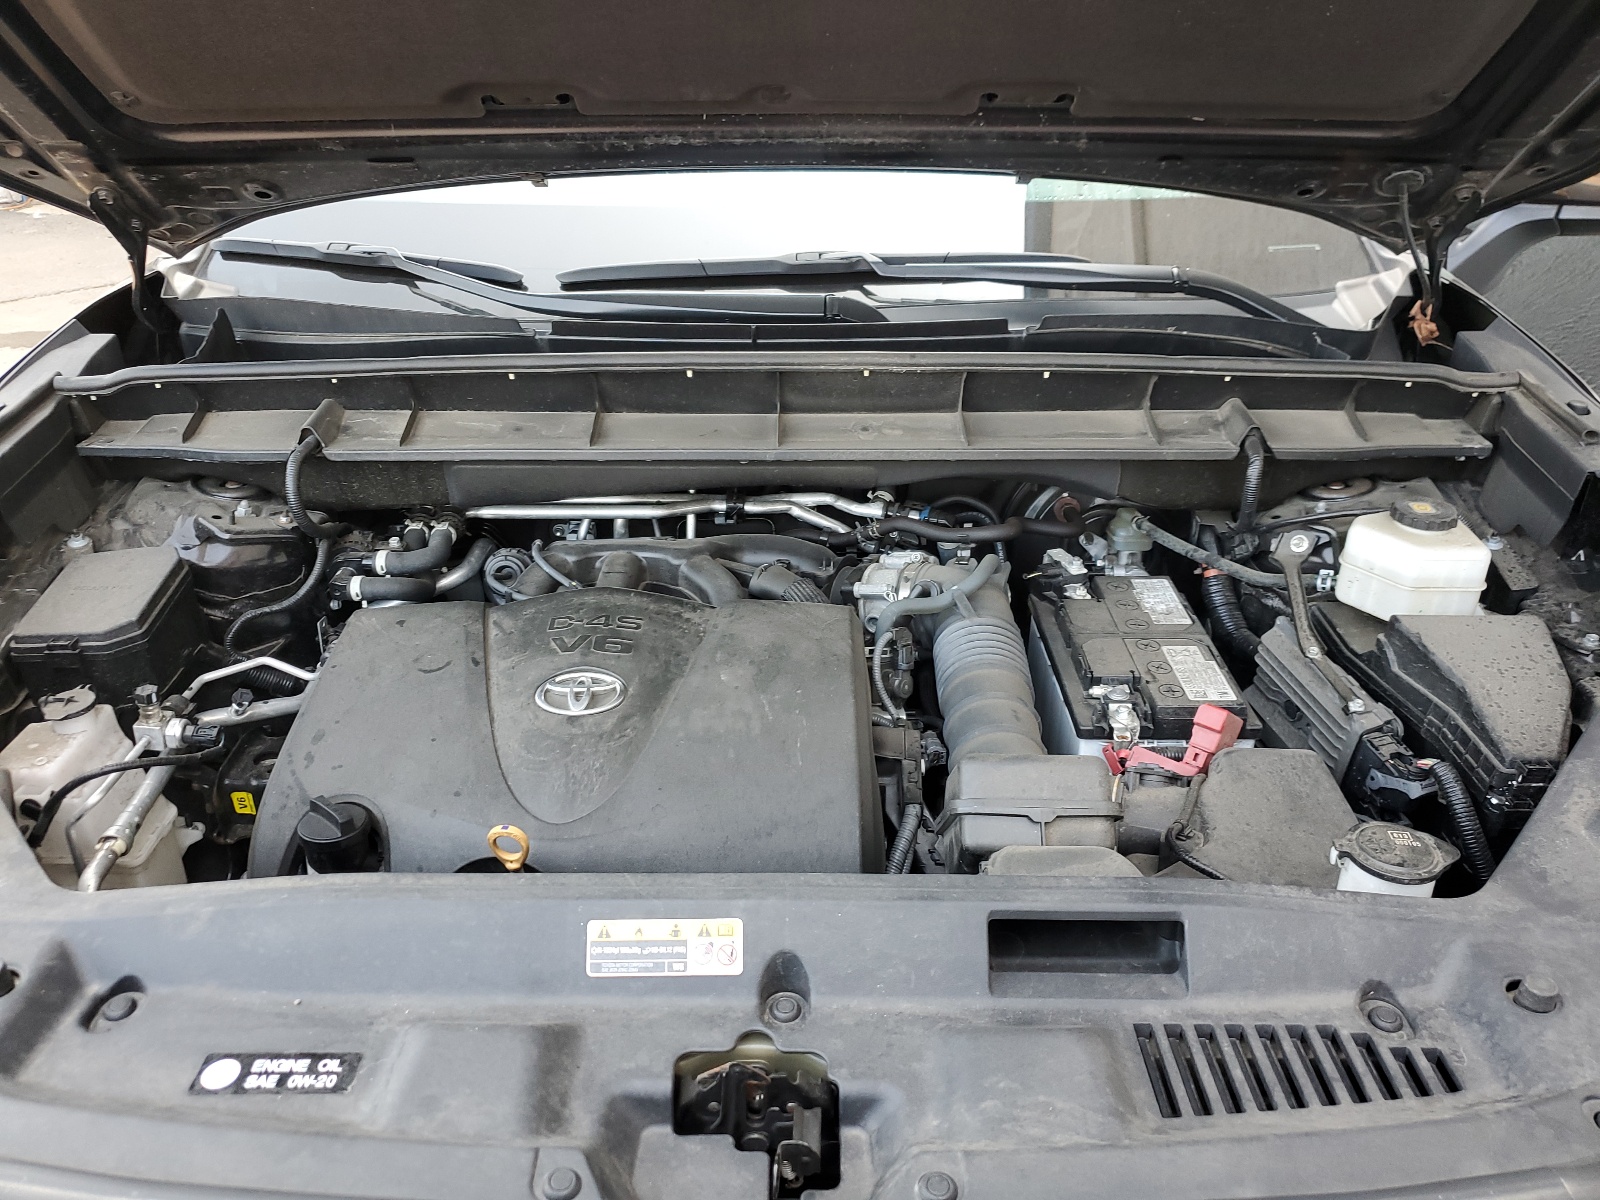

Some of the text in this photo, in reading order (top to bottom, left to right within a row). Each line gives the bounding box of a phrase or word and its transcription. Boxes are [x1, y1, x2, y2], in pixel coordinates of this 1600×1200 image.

[547, 614, 643, 632] D-4S
[551, 634, 634, 655] V6
[237, 797, 248, 809] V6
[250, 1058, 343, 1073] ENGINE OIL
[243, 1074, 337, 1089] SAE 0W-20
